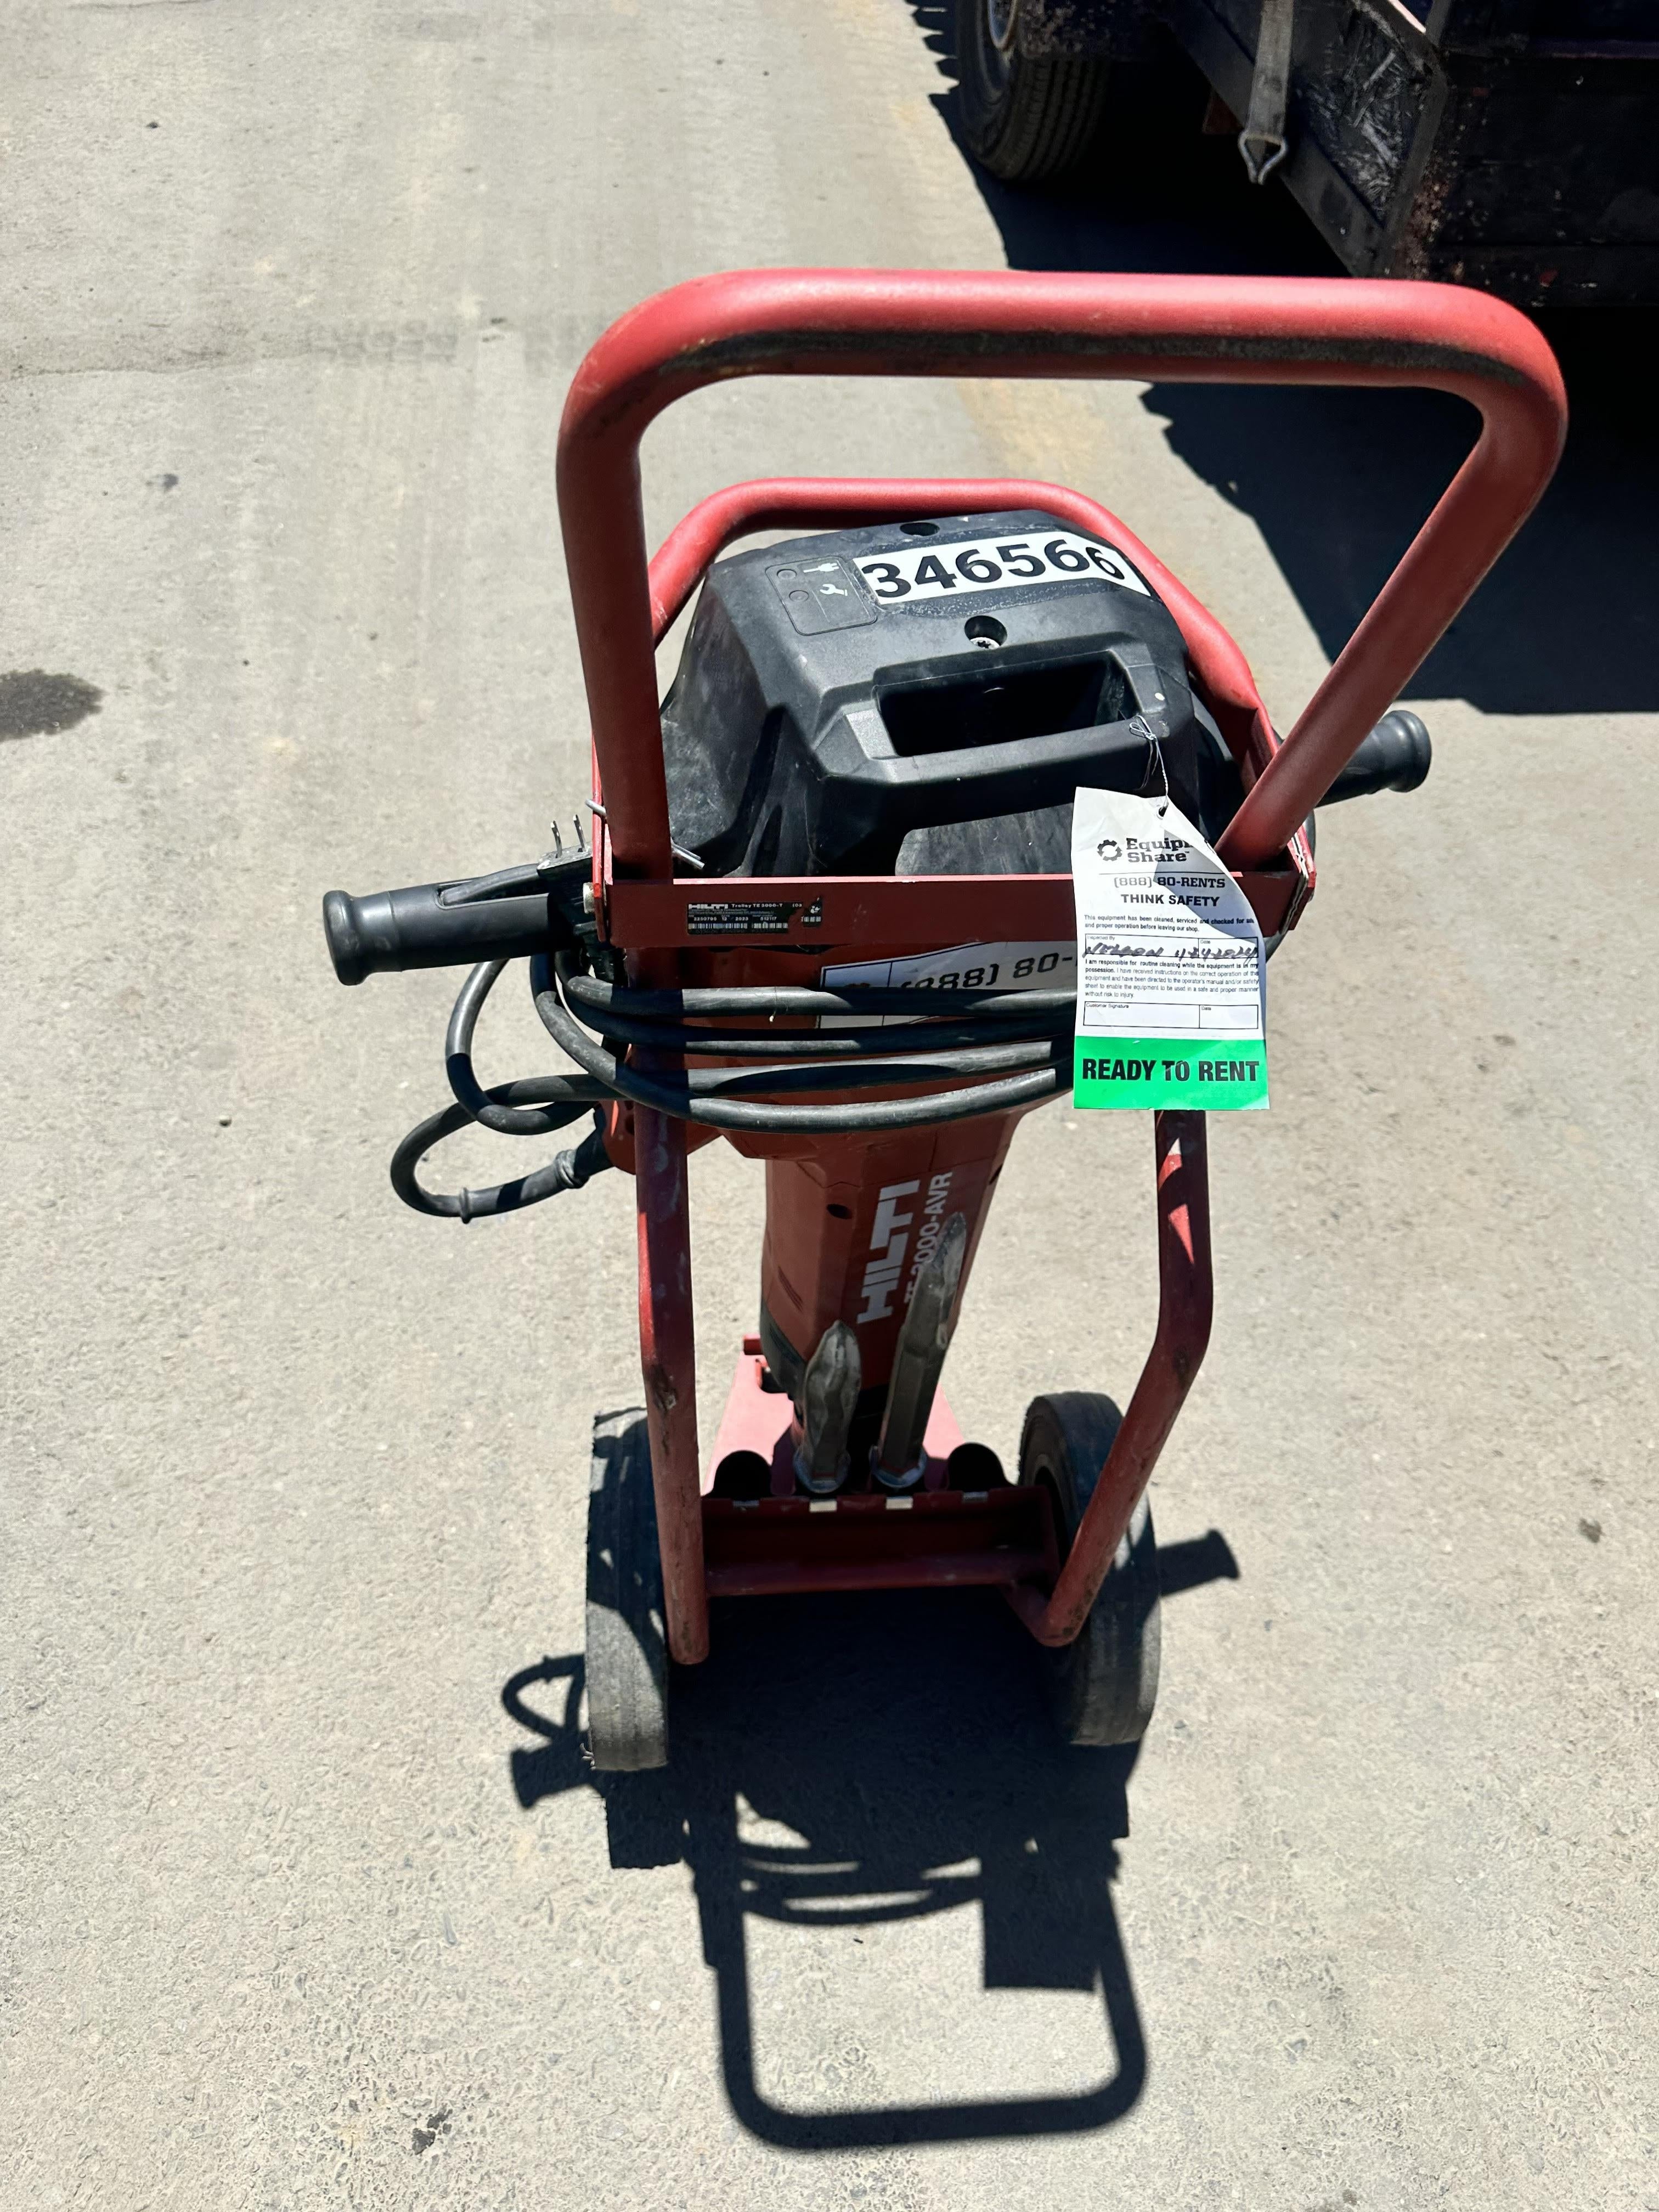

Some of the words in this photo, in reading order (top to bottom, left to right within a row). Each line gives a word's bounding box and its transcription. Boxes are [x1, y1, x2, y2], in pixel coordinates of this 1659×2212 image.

[863, 538, 1125, 599] 346566
[1114, 877, 1152, 888] (888)
[1158, 877, 1225, 888] 80-RENTS
[1121, 894, 1164, 904] THINK
[1169, 895, 1220, 906] SAFETY
[1082, 1058, 1156, 1081] READY
[1161, 1060, 1190, 1081] TO
[1198, 1060, 1259, 1081] RENT
[857, 1180, 921, 1324] HILTI
